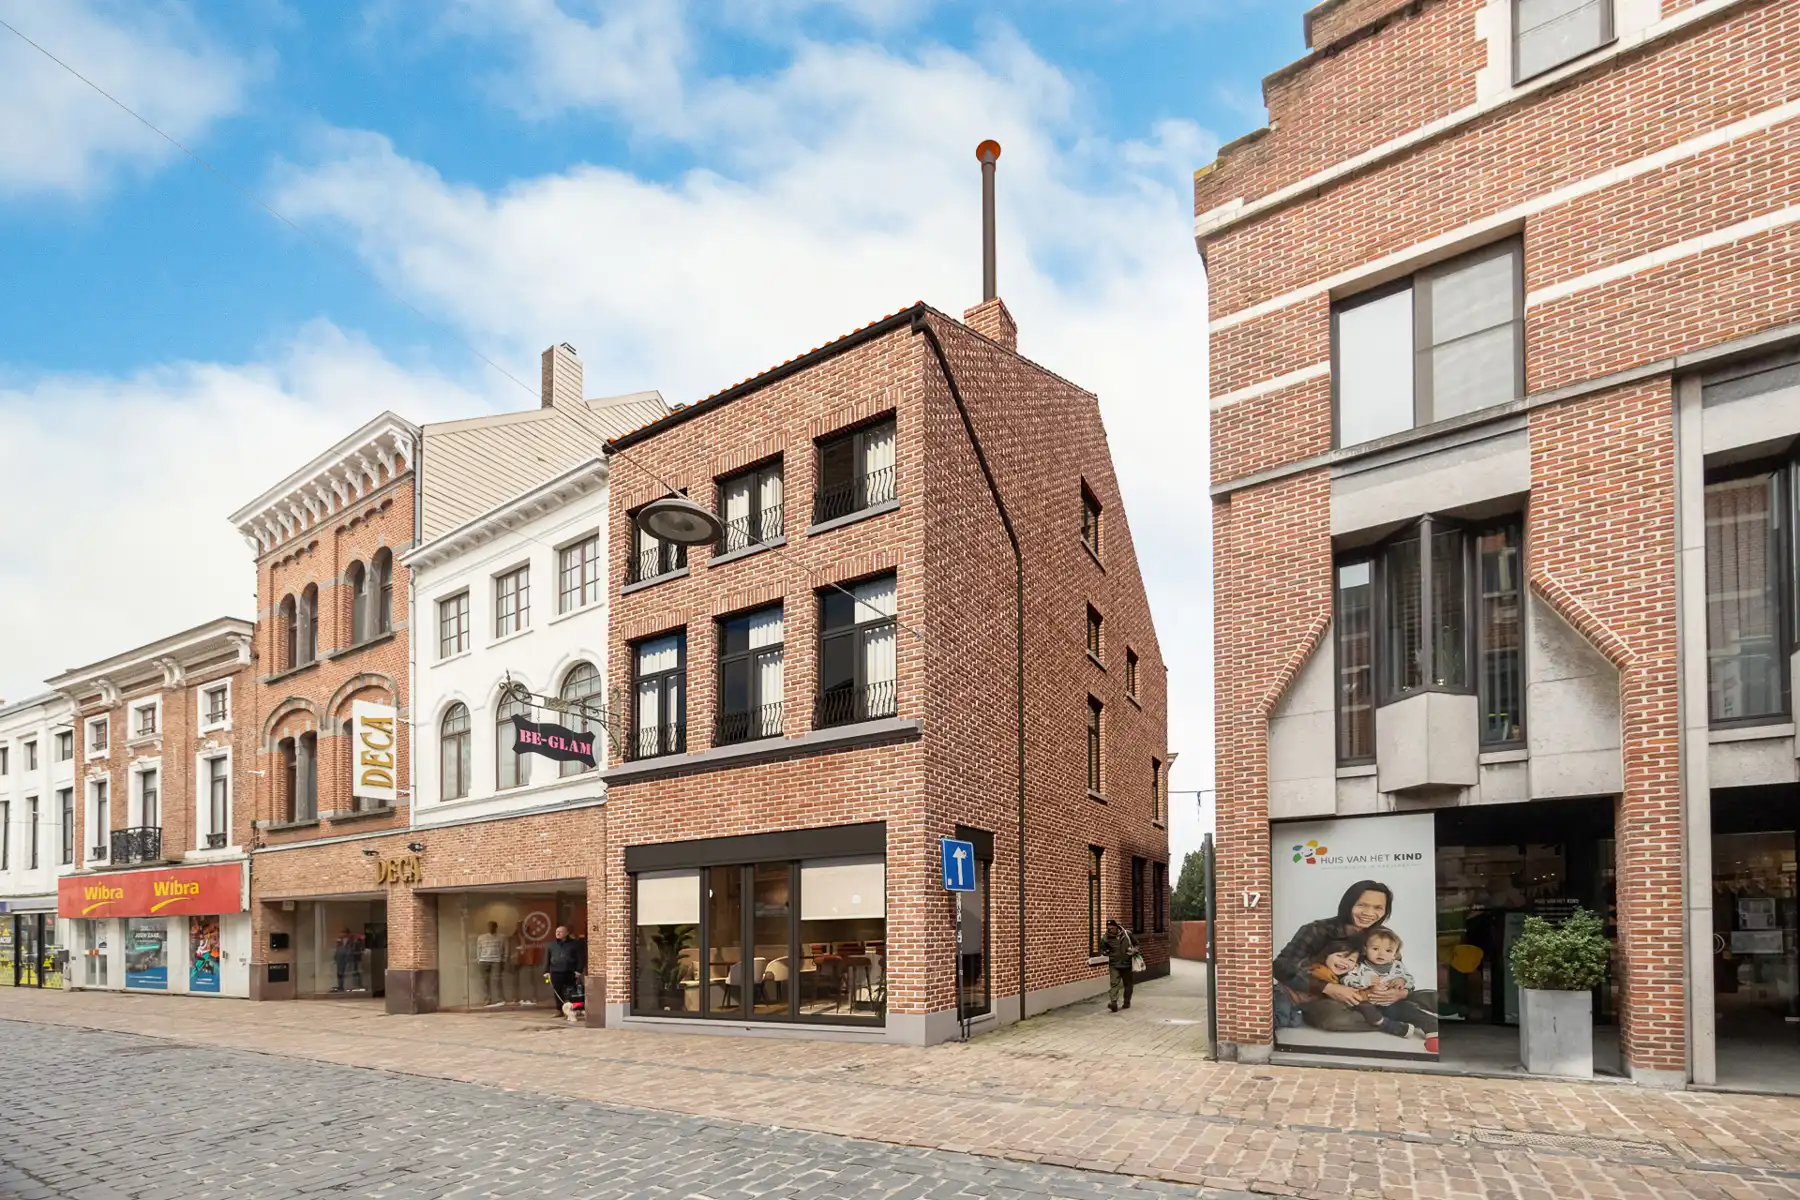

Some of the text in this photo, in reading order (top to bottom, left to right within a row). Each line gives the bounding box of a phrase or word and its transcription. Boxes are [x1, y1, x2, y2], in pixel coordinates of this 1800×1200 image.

[519, 729, 591, 755] BE-GLAM
[360, 716, 394, 790] DECA
[376, 855, 422, 884] DECA
[1321, 853, 1422, 865] HUIS VAN HET KIND
[84, 882, 124, 900] Wibra
[153, 876, 199, 897] Wibra
[1241, 892, 1261, 907] 17
